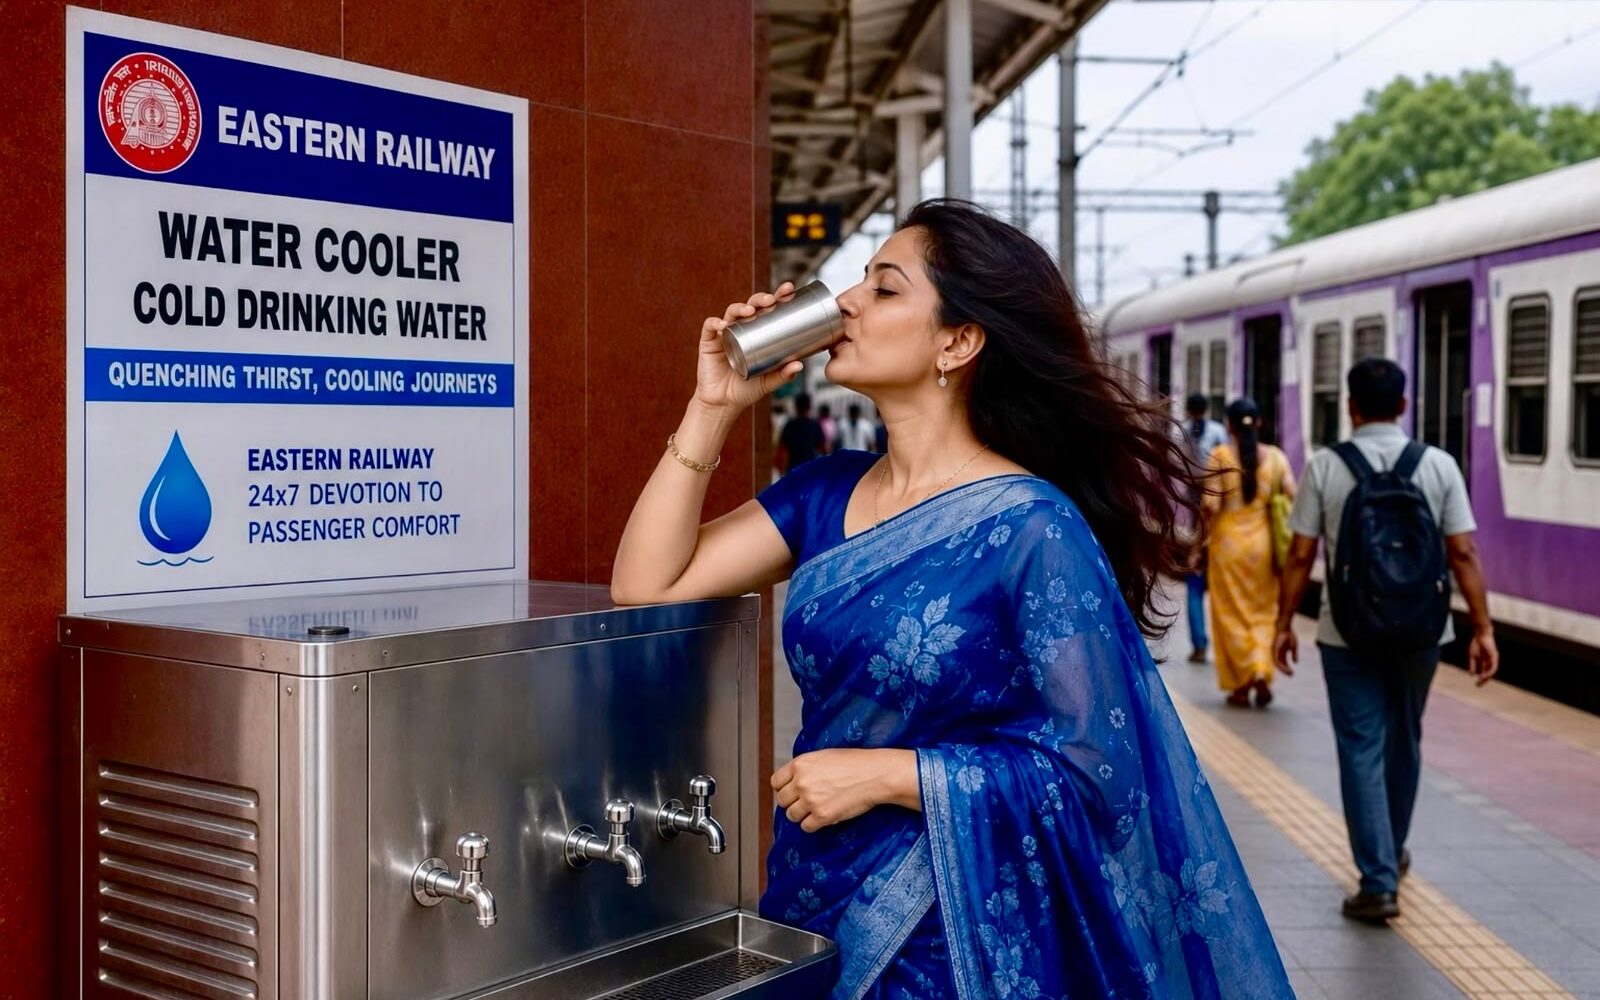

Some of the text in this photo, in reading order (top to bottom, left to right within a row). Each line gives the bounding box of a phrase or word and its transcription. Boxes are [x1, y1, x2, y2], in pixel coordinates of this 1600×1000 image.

[218, 105, 366, 163] EASTERN
[376, 131, 496, 180] RAILWAY
[158, 210, 461, 283] WATER COOLER
[133, 281, 487, 341] COLD DRINKING WATER
[108, 361, 498, 395] QUENCHING THIRST, COOLING JOURNEYS
[248, 447, 435, 472] EASTERN RAILWAY
[248, 480, 443, 507] 24x7 DEVOTION TO
[248, 513, 461, 544] PASSENGER COMFORT
